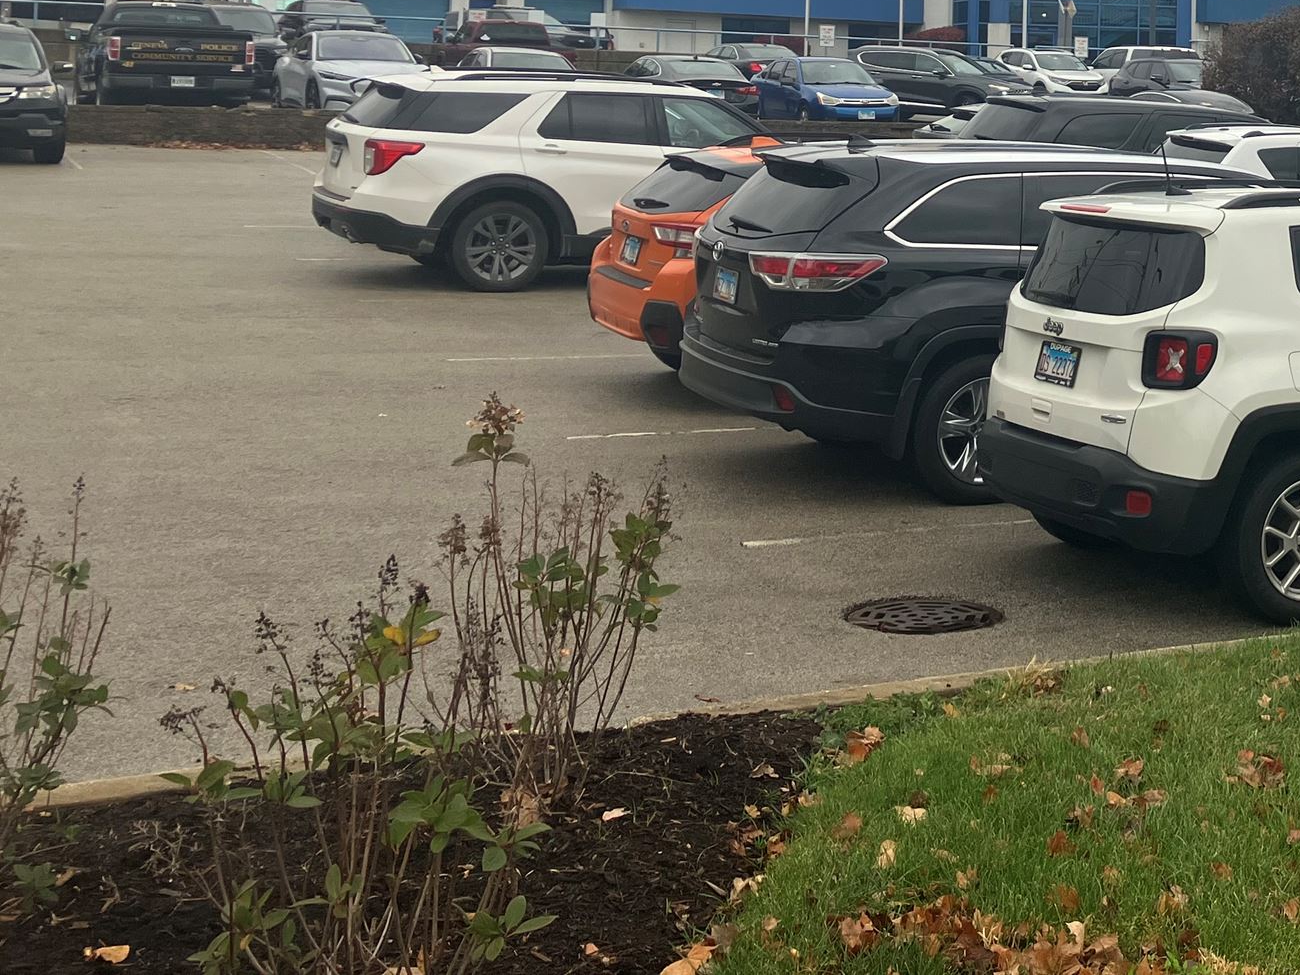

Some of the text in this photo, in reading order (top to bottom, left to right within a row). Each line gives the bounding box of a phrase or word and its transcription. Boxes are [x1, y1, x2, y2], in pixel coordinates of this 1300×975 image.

[200, 43, 239, 51] POLICE
[131, 52, 234, 62] COMMUNITY SERVICE
[1043, 317, 1064, 336] Jeep
[1050, 342, 1073, 354] DUPAGE
